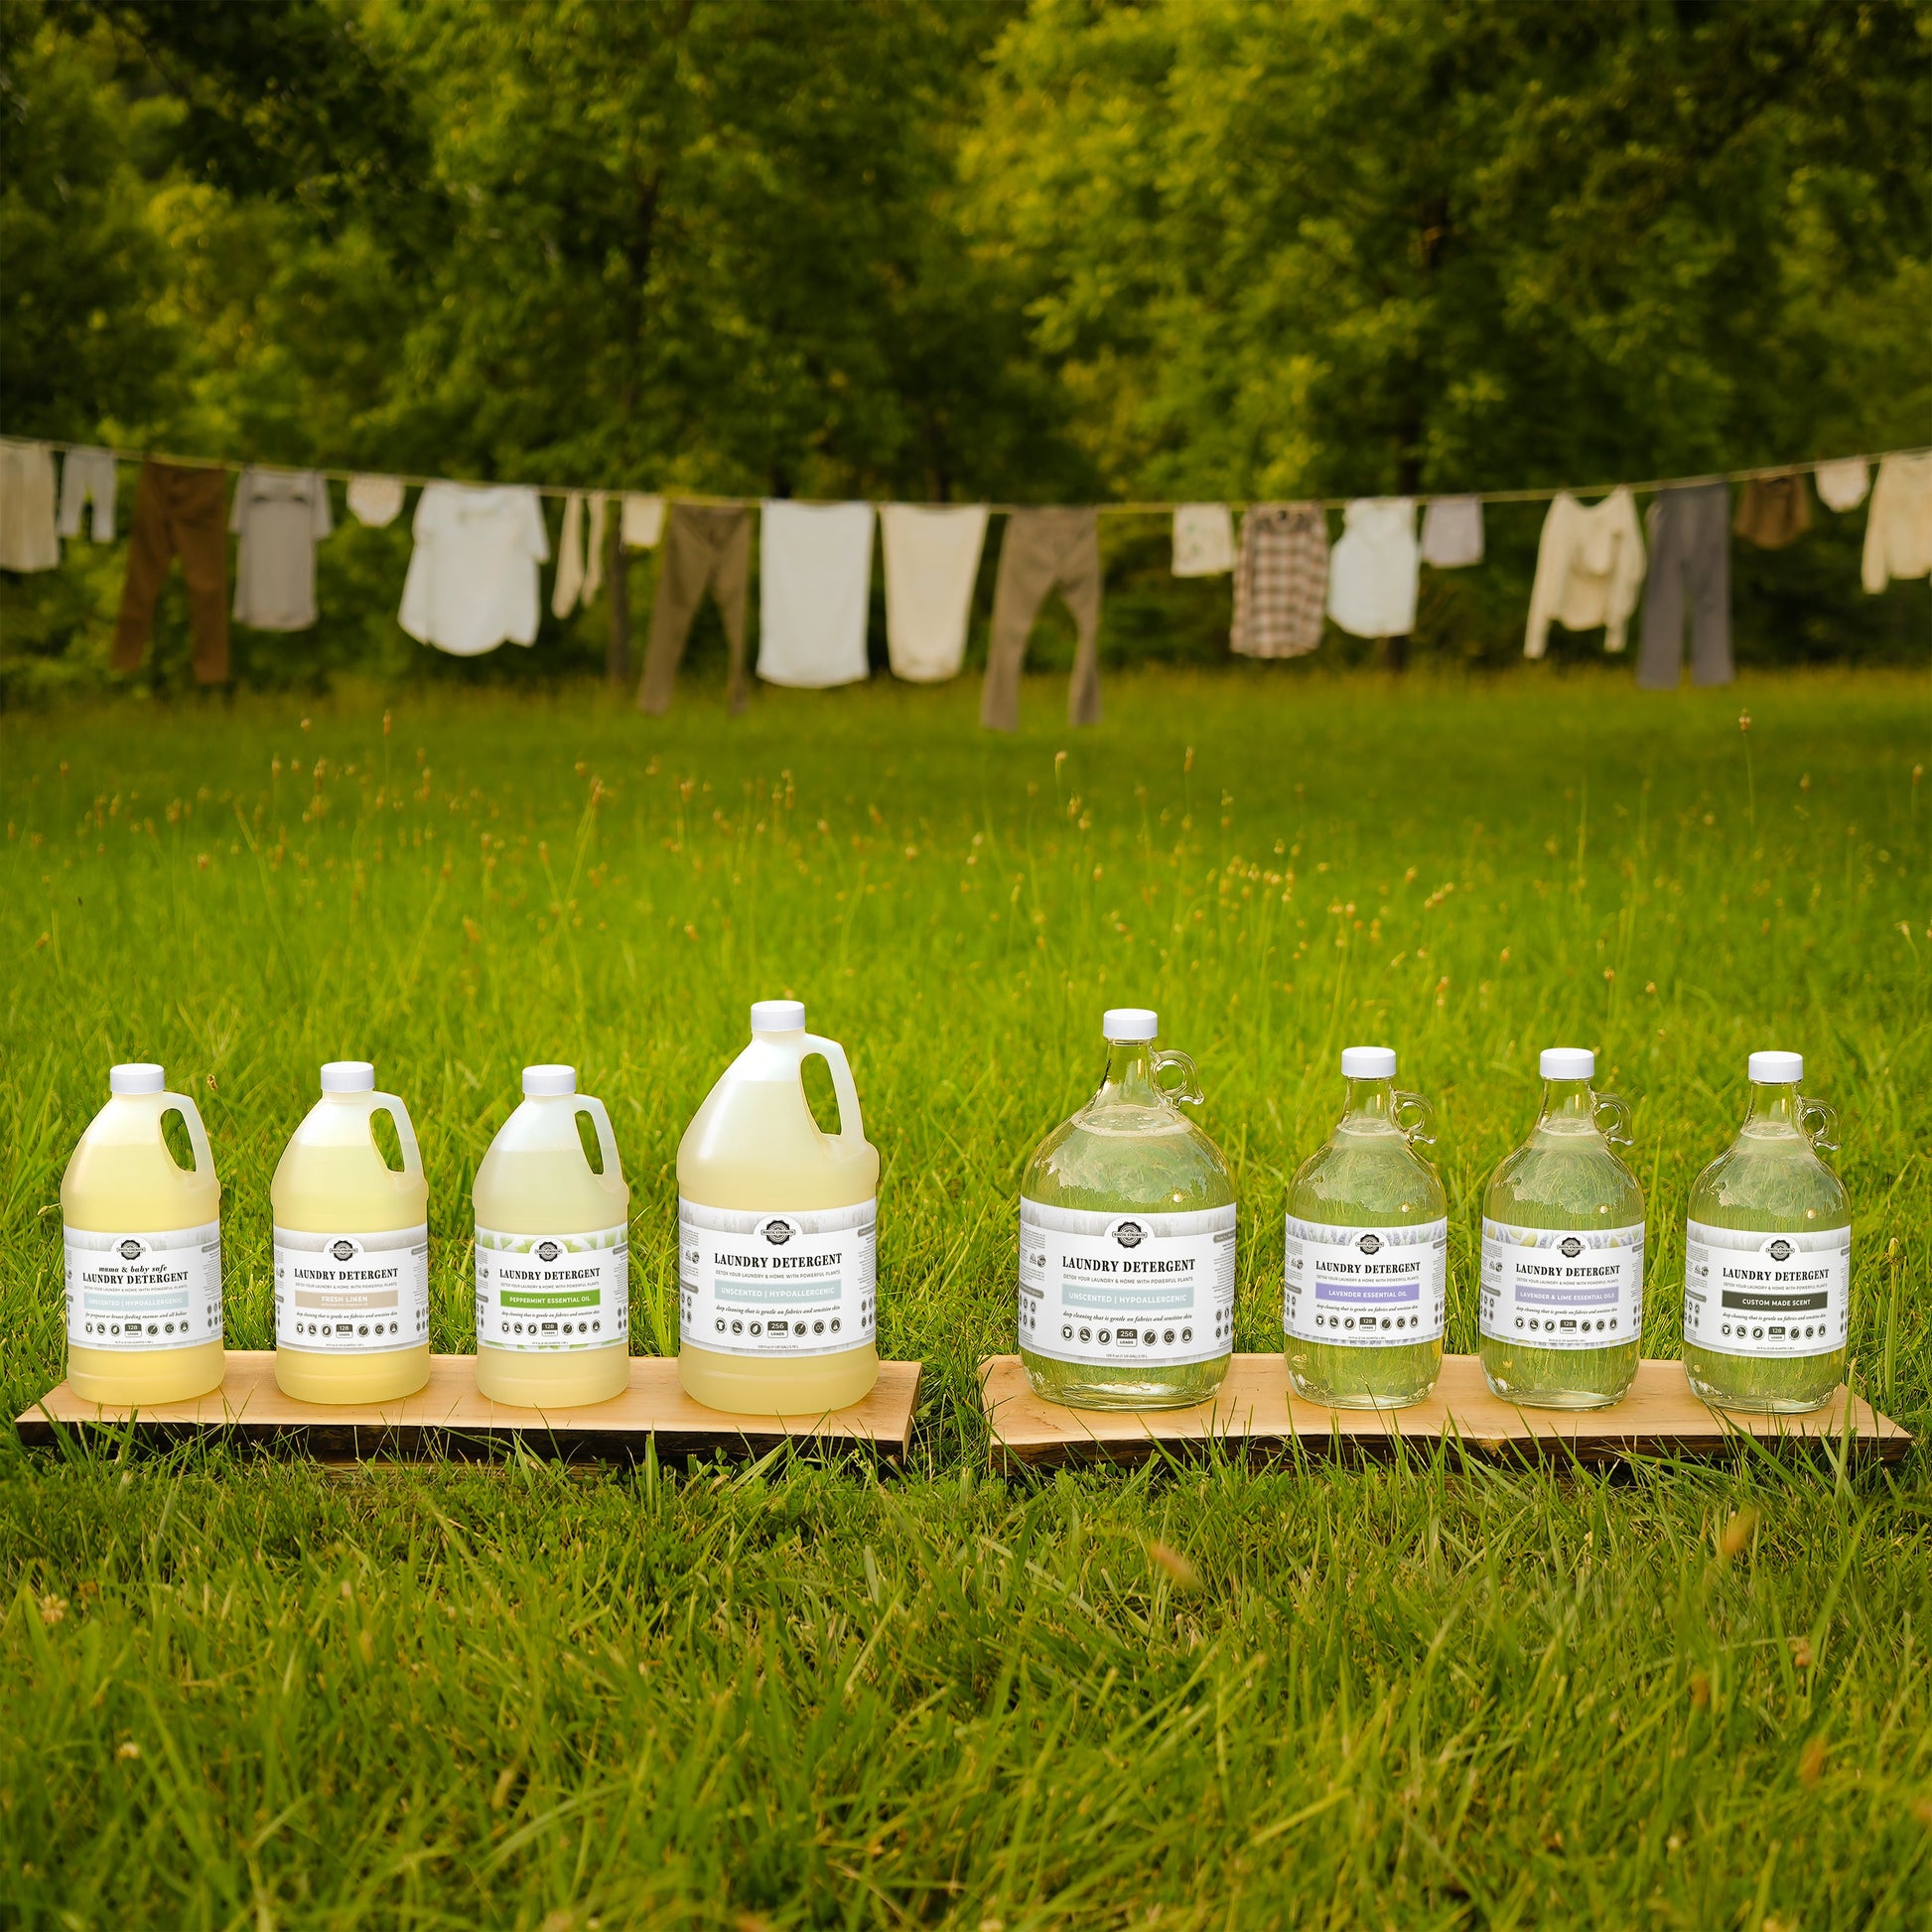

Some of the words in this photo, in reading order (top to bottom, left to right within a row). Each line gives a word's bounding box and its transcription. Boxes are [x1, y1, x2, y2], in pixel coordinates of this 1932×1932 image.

[714, 1253, 768, 1269] LAUNDRY
[772, 1252, 842, 1269] DETERGENT
[1062, 1255, 1119, 1272] LAUNDRY
[1123, 1258, 1195, 1273] DETERGENT
[1315, 1260, 1361, 1274] LAUNDRY
[1364, 1262, 1421, 1274] DETERGENT
[151, 1264, 168, 1273] safe
[294, 1268, 336, 1281] LAUNDRY
[339, 1268, 398, 1281] DETERGENT
[499, 1268, 541, 1281] LAUNDRY
[544, 1267, 601, 1281] DETERGENT
[1516, 1263, 1563, 1277] LAUNDRY
[1566, 1265, 1620, 1277] DETERGENT
[1723, 1267, 1772, 1281] LAUNDRY
[1774, 1269, 1830, 1282] DETERGENT
[82, 1272, 124, 1284] LAUNDRY
[127, 1271, 189, 1284] DETERGENT
[721, 1287, 762, 1297] UNSCENTED
[769, 1287, 835, 1298] HYPOALLERGENIC
[1068, 1292, 1112, 1303] UNSCENTED
[1119, 1294, 1187, 1304] HYPOALLERGENIC
